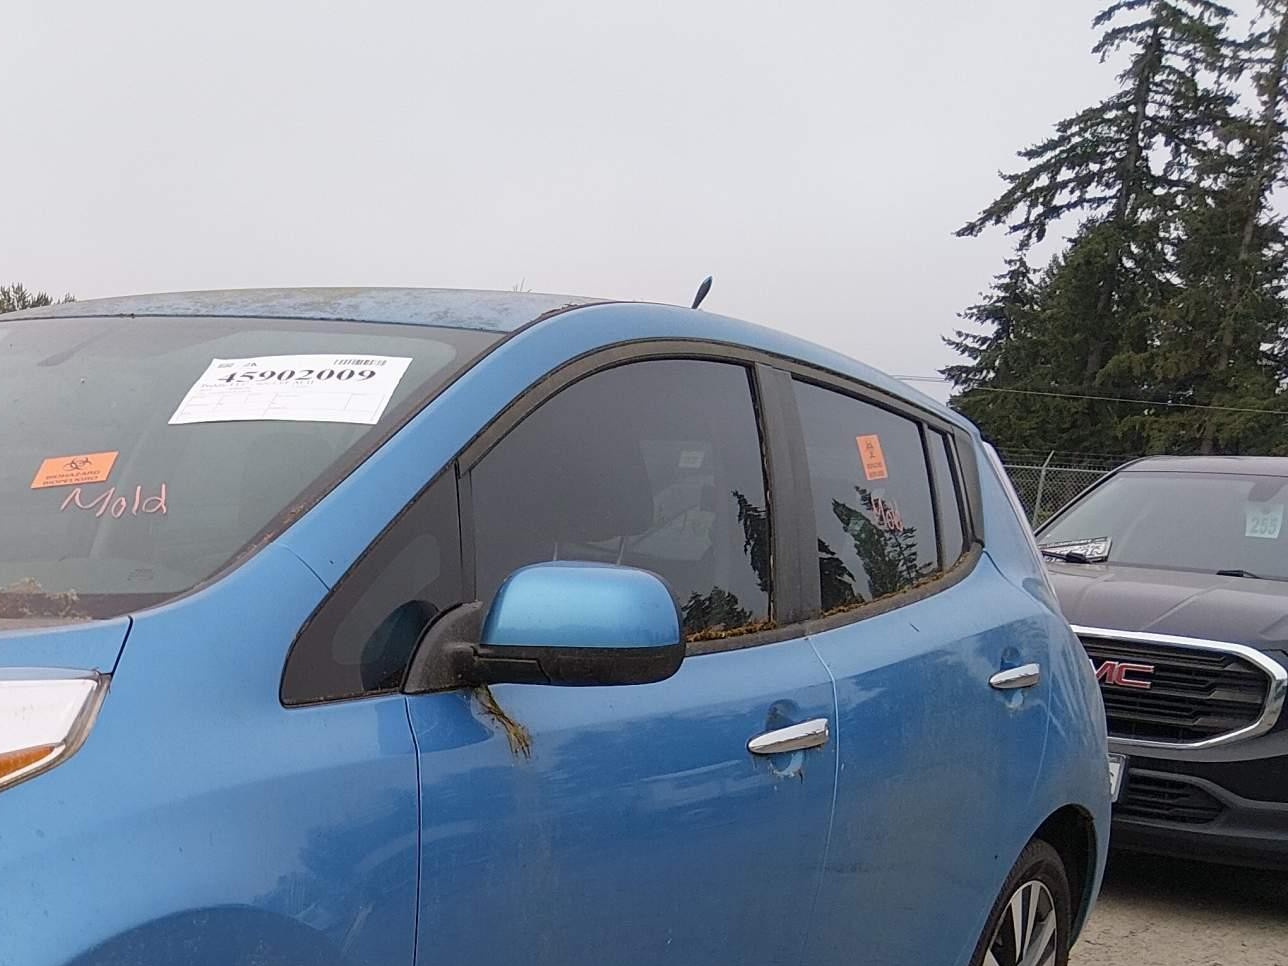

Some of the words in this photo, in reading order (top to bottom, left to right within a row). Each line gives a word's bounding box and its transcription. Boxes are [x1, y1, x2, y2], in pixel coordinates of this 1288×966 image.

[217, 368, 377, 383] 45902009
[59, 482, 167, 518] Mold
[1089, 659, 1155, 689] MC
